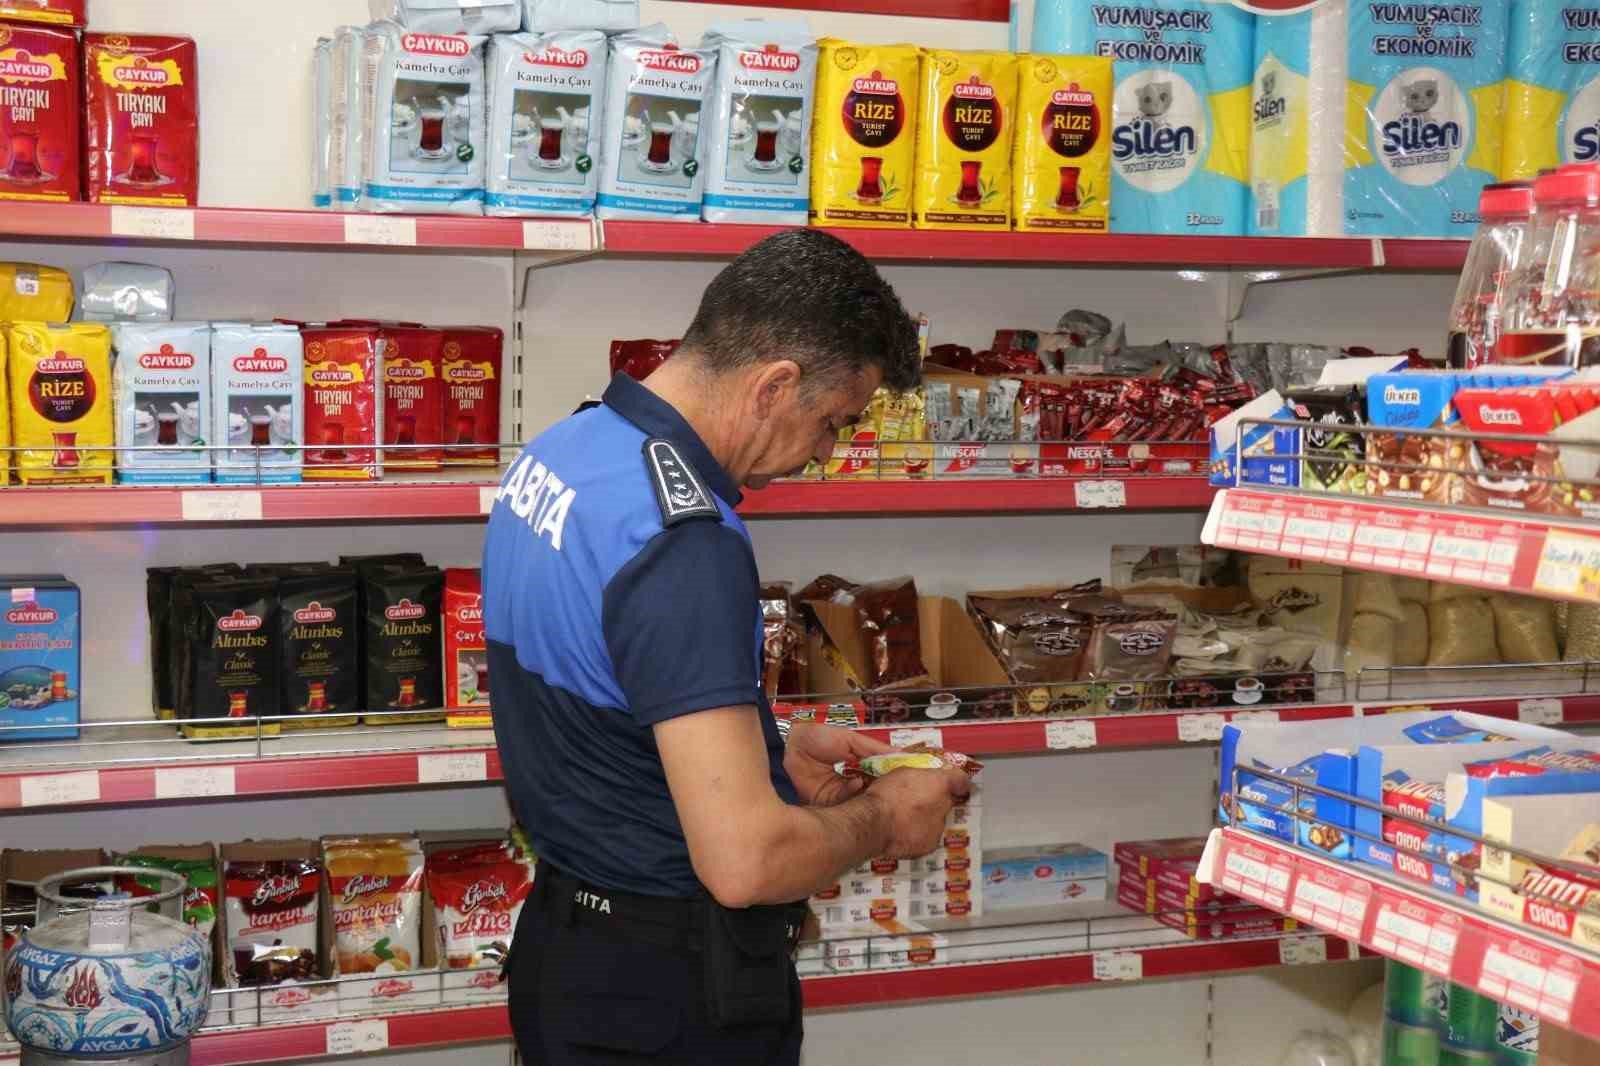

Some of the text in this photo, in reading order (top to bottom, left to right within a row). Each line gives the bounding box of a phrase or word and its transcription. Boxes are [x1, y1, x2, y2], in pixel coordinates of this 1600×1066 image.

[1094, 7, 1212, 31] YUMUŞACIK
[1372, 5, 1481, 25] YUMUŞACIK
[1144, 30, 1161, 42] ve
[1416, 25, 1432, 37] ve
[404, 34, 467, 54] ÇAYKUR
[1374, 36, 1475, 58] EKONOMİK
[1097, 40, 1205, 64] EKONOMİK
[743, 52, 799, 69] ÇAYKUR
[115, 67, 167, 83] ÇAYKUR
[516, 70, 593, 89] Kamelya Çayı
[679, 78, 703, 94] Çayı
[733, 77, 805, 91] Kamelya Çayı
[854, 78, 897, 94] ÇAYKUR
[954, 84, 993, 98] ÇAYKUR
[1053, 91, 1093, 104] ÇAYKUR
[11, 107, 35, 123] ÇAYI
[854, 101, 896, 120] RİZE
[954, 105, 993, 124] RİZE
[1254, 96, 1286, 122] Silen
[131, 112, 154, 129] ÇAYI
[1052, 111, 1092, 131] RİZE
[865, 129, 883, 138] ÇAYI
[964, 133, 982, 142] ÇAYI
[1111, 119, 1197, 159] Silen
[1381, 115, 1461, 154] Silen
[38, 358, 85, 372] ÇAYKUR
[140, 354, 193, 369] ÇAYKUR
[235, 358, 286, 372] ÇAYKUR
[313, 370, 353, 381] ÇAYKUR
[387, 367, 425, 378] ÇAYKUR
[450, 368, 485, 379] ÇAYKUR
[40, 380, 85, 397] RİZE
[133, 375, 200, 387] Kamelya Çayı
[228, 379, 270, 391] Kamelya
[1384, 386, 1420, 405] ÜLKER
[324, 404, 343, 417] ÇAYI
[397, 398, 415, 410] ÇAYI
[458, 399, 475, 411] ÇAYI
[492, 450, 577, 551] ABITA
[8, 610, 55, 623] ÇAYKUR
[296, 610, 334, 621] ÇAYKUR
[388, 606, 423, 617] ÇAYKUR
[222, 619, 258, 629] ÇAYKUR
[456, 630, 475, 643] Çay
[19, 947, 59, 967] AYGAZ
[80, 1038, 142, 1053] AYGAZ
